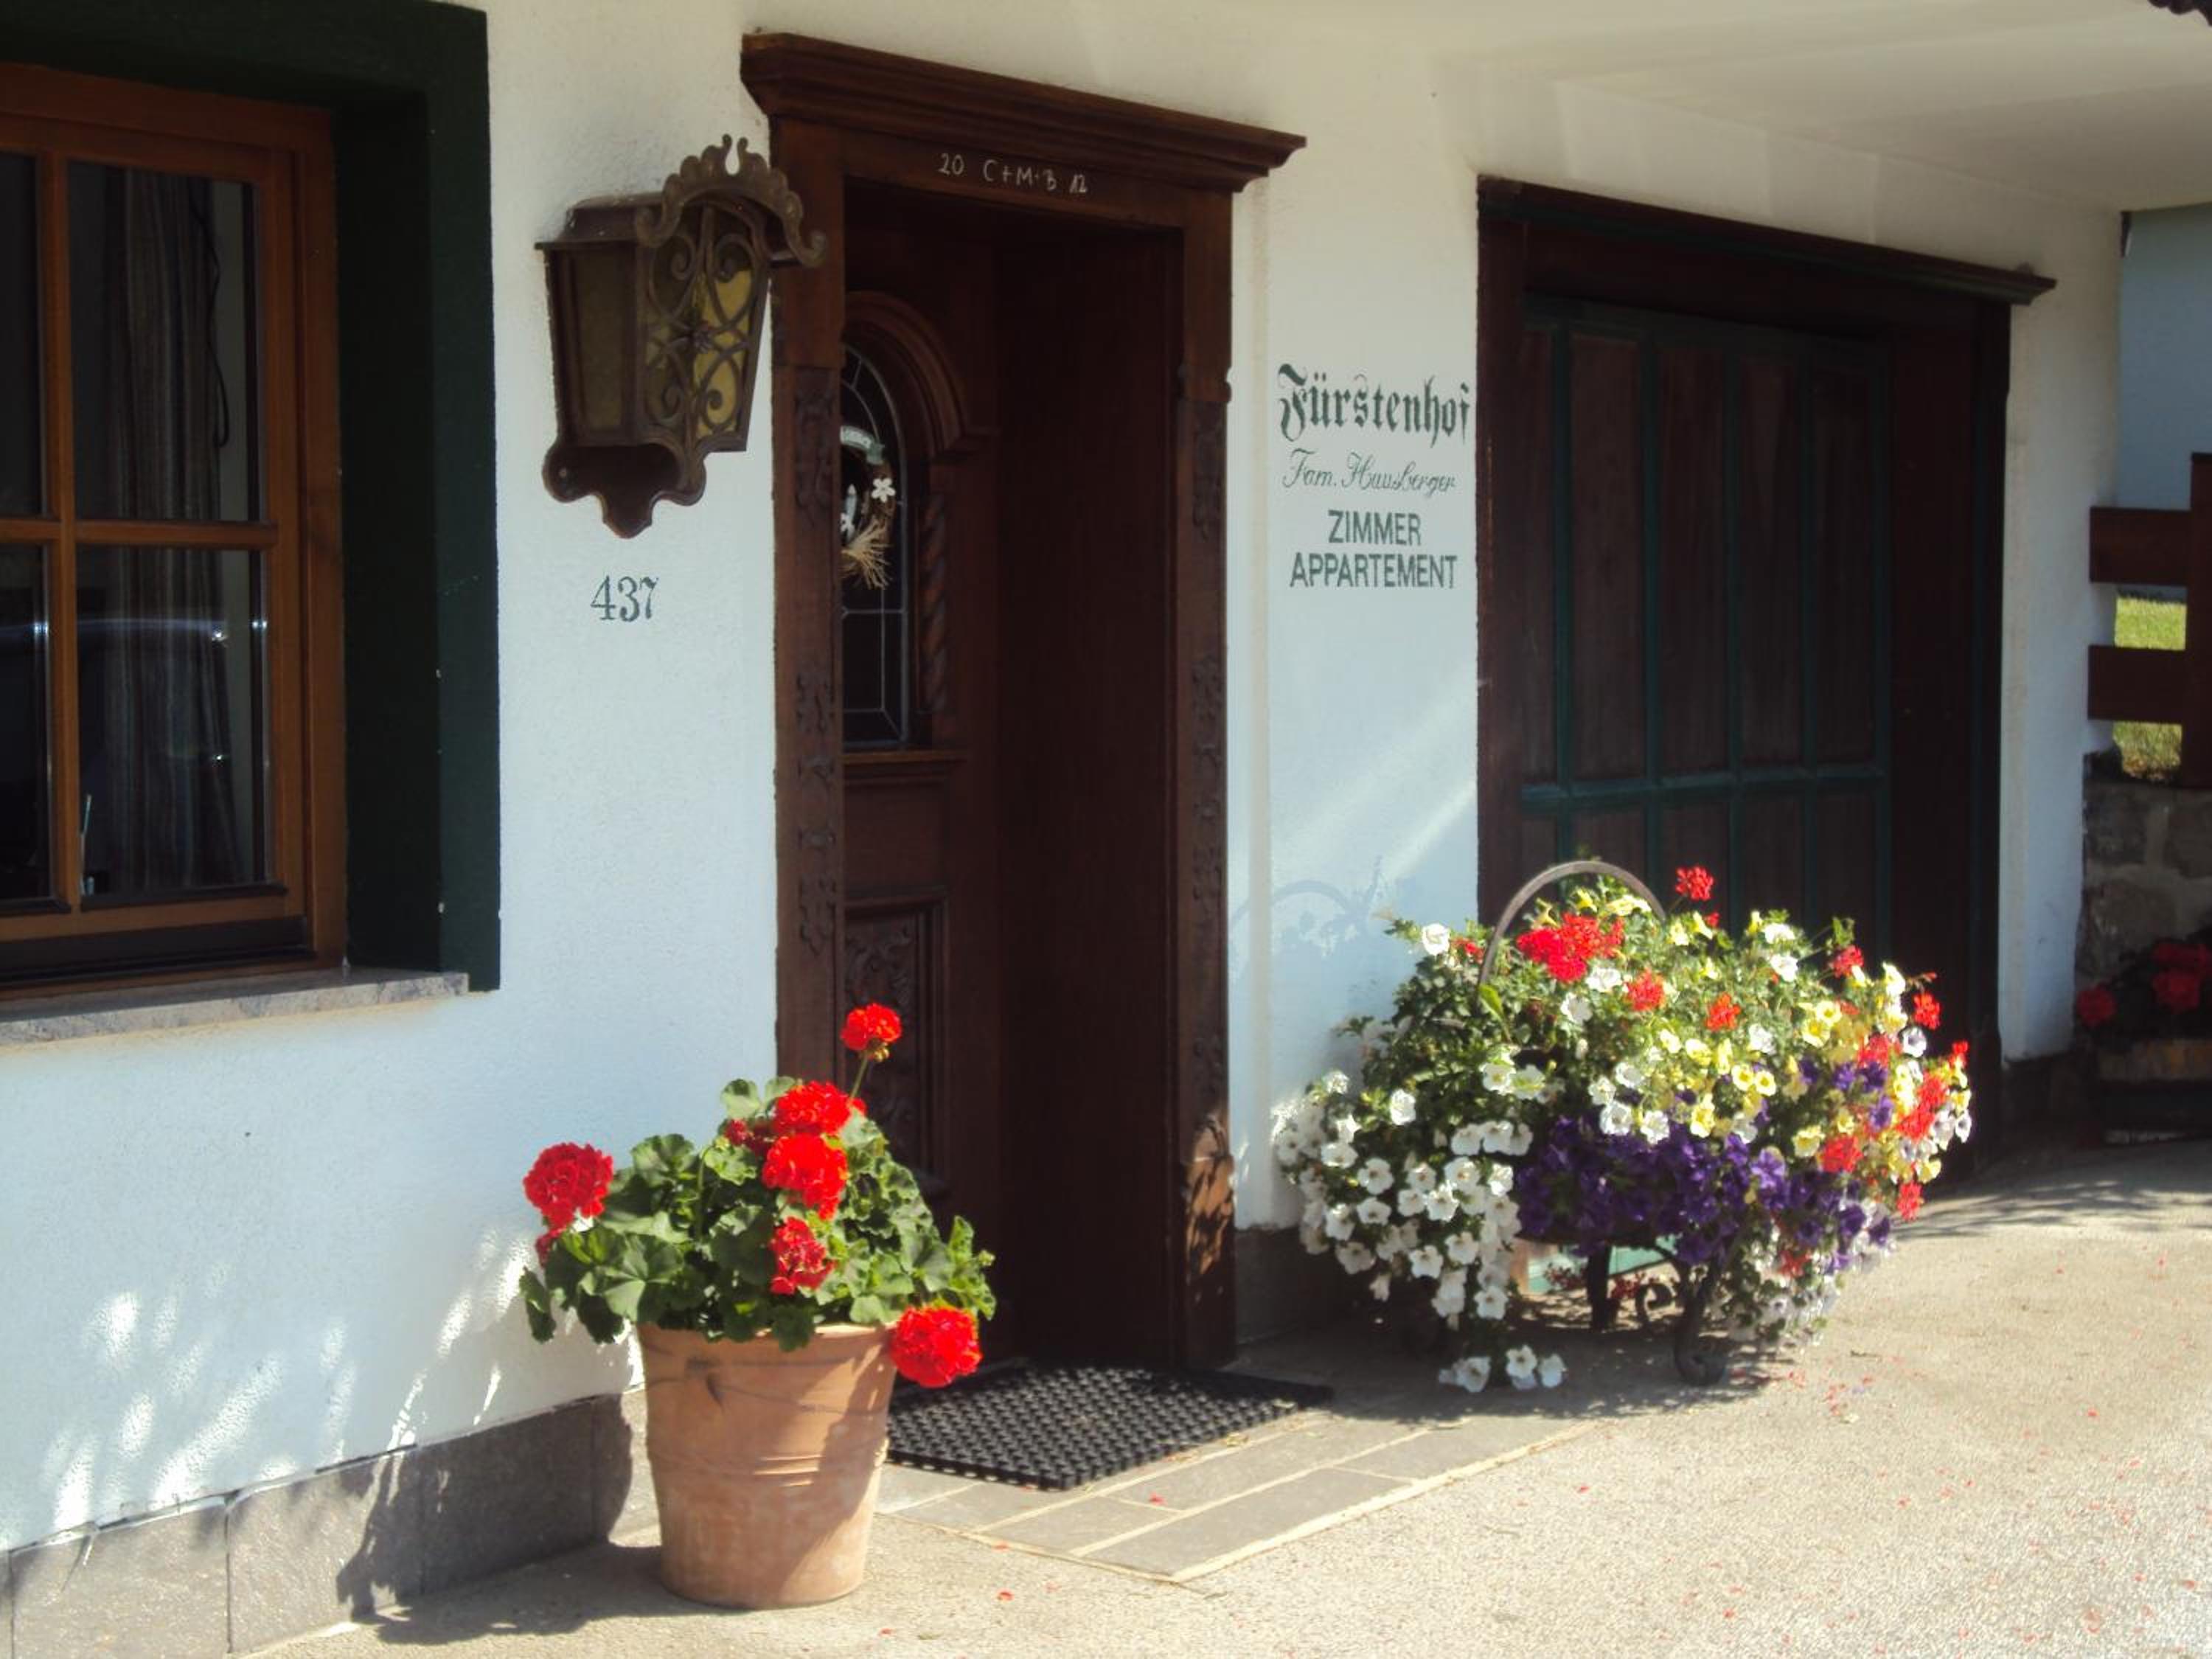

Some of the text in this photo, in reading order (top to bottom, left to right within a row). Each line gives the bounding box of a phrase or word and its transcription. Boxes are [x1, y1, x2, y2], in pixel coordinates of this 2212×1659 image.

[938, 153, 964, 175] 20
[1278, 364, 1471, 448] Fürstenhof
[1282, 447, 1337, 489] Fam.
[1327, 509, 1422, 546] ZIMMER
[1290, 552, 1458, 589] APPARTEMENT
[590, 575, 659, 622] 437
